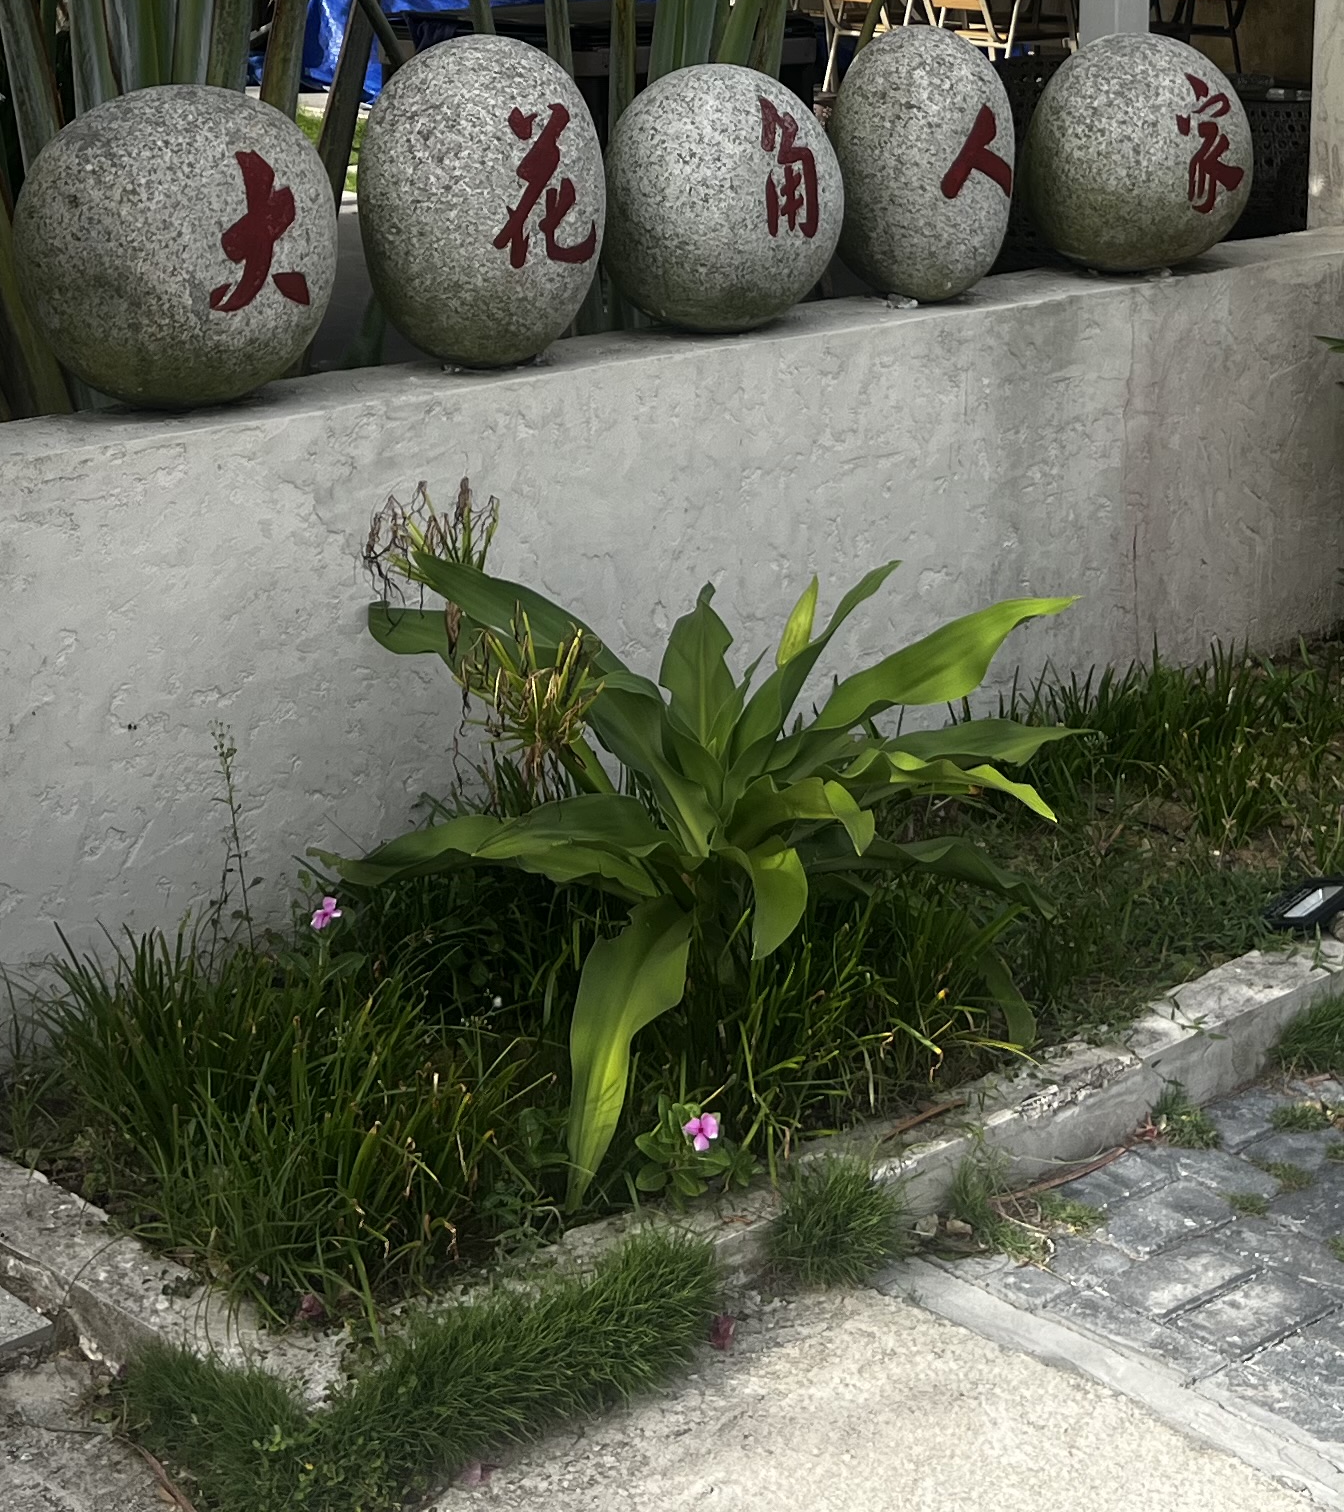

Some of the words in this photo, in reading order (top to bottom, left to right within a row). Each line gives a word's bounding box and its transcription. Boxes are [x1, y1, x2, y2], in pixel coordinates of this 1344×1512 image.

[492, 102, 598, 269] 花
[940, 102, 1012, 200] 人
[1175, 72, 1245, 214] 家
